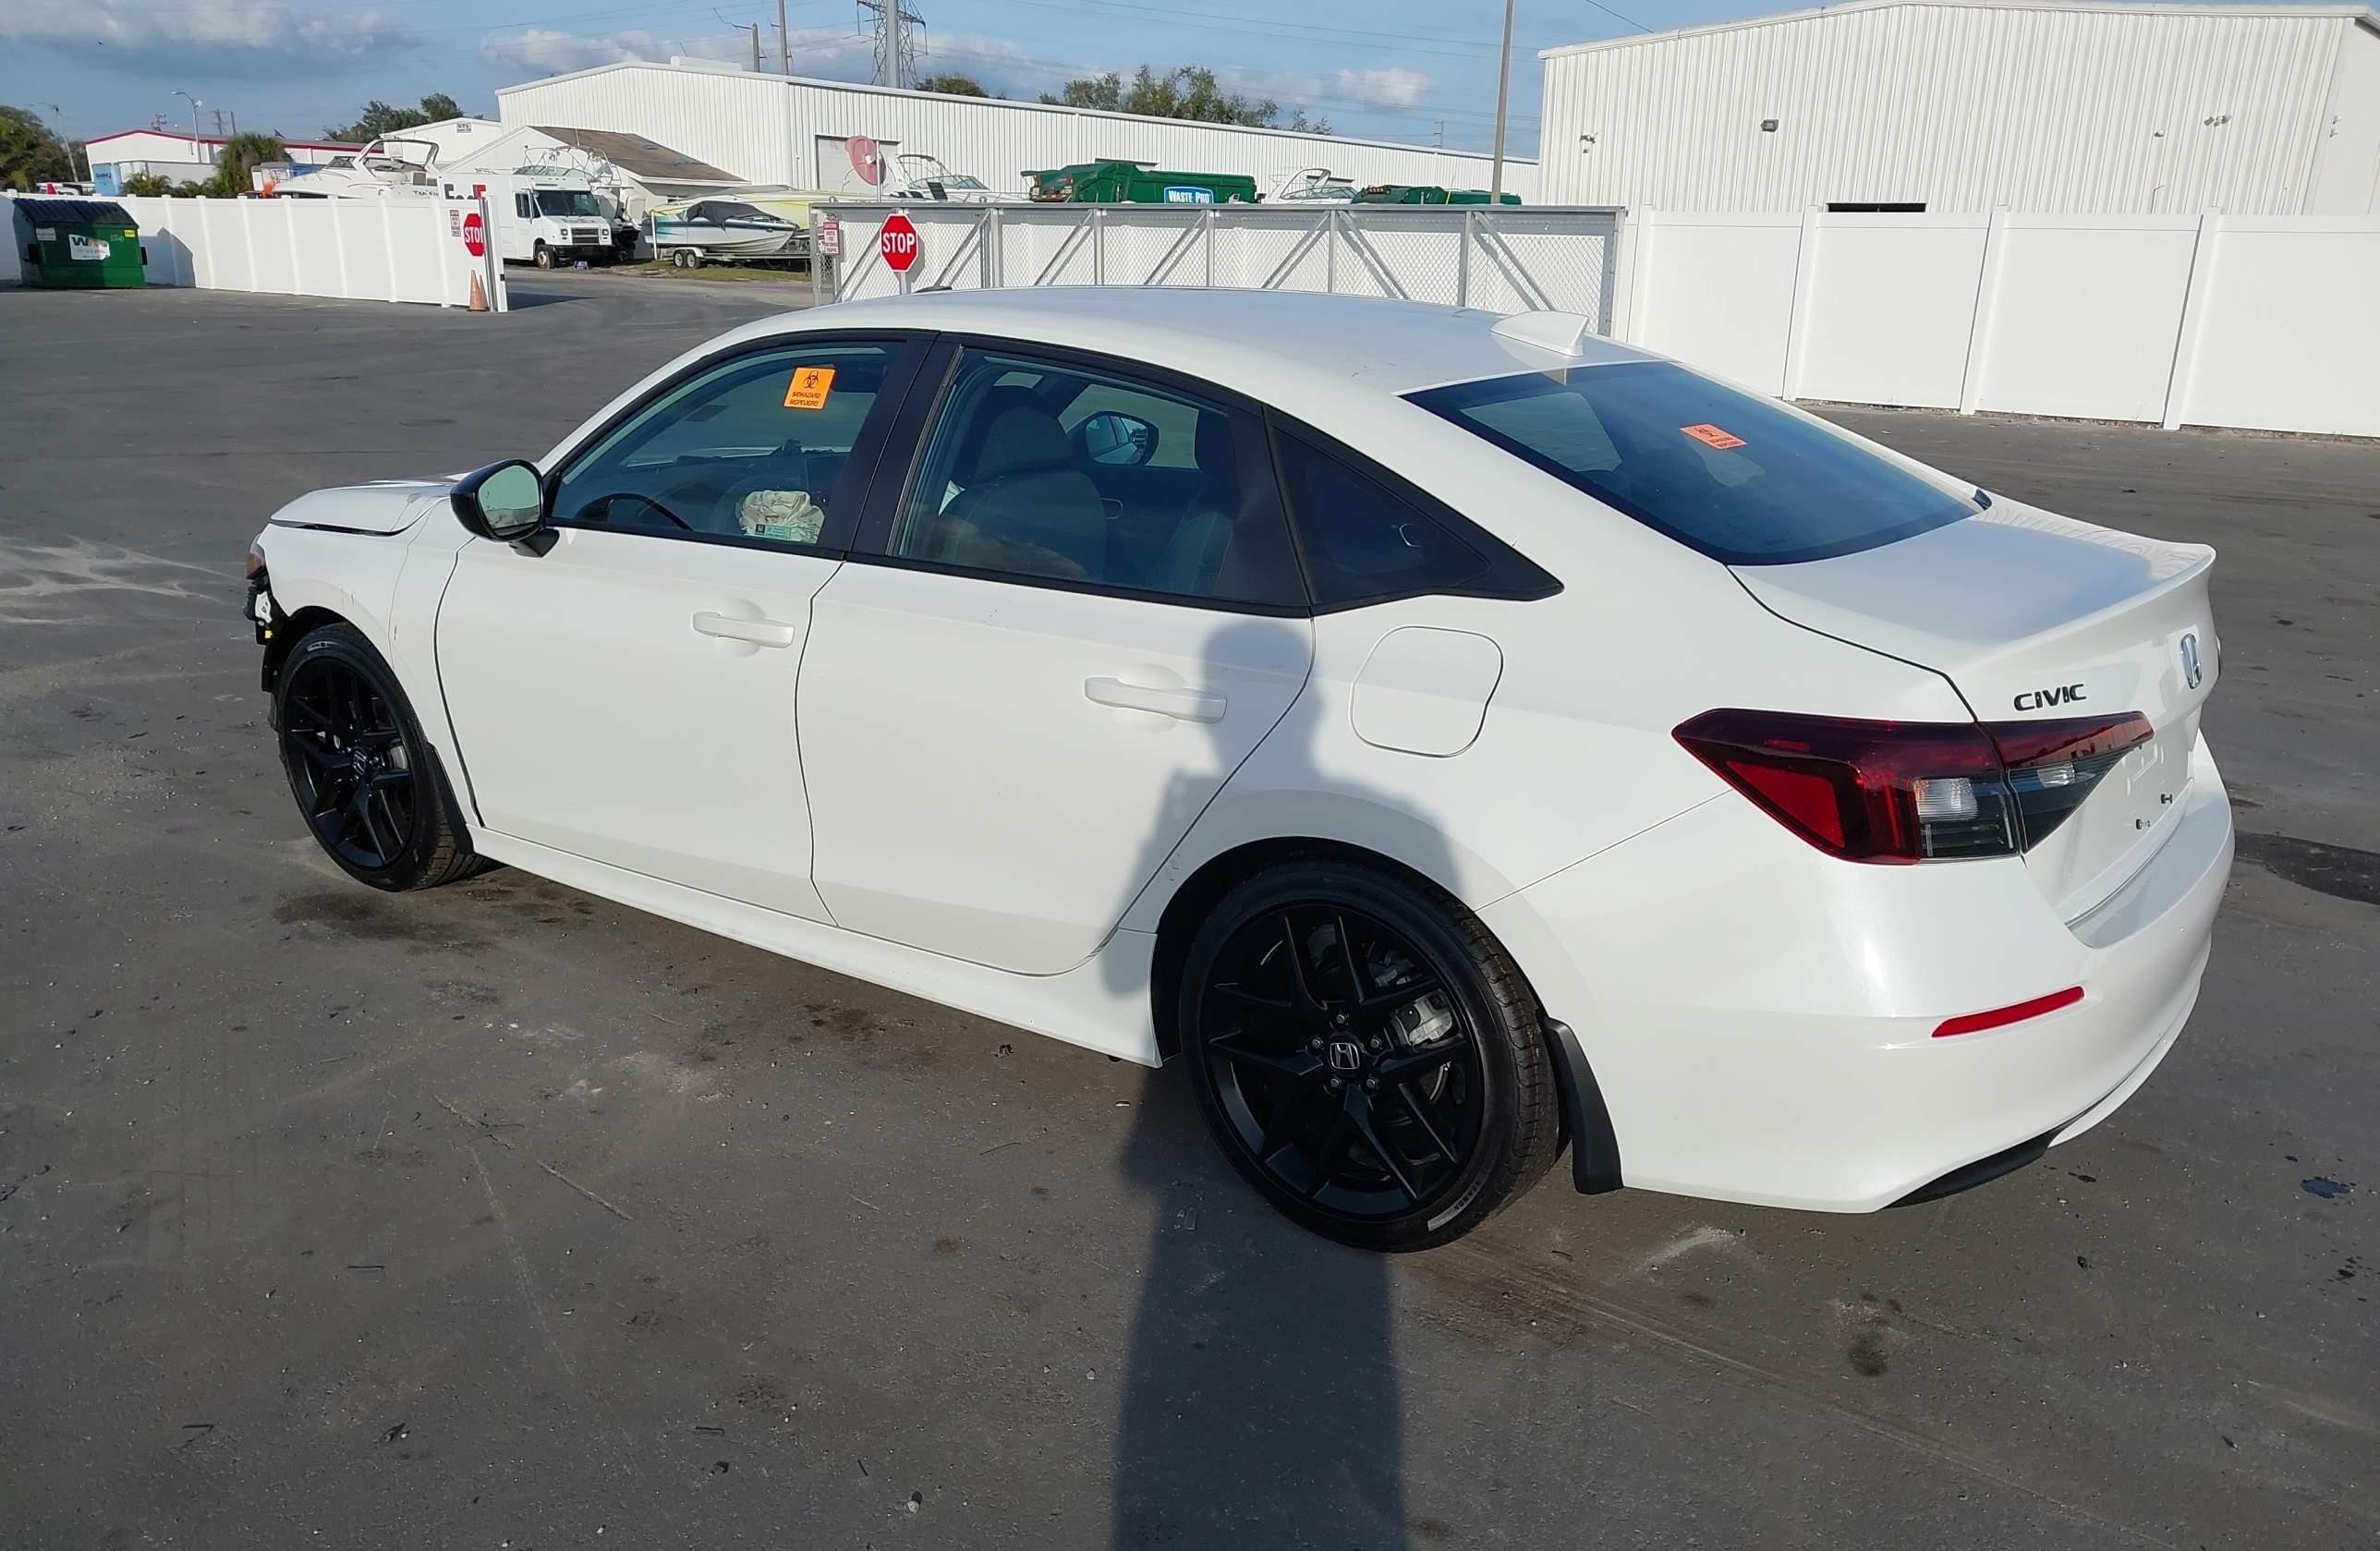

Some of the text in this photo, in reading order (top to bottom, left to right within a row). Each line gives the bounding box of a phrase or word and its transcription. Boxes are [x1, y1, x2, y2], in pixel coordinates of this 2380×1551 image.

[1168, 190, 1209, 204] WASTE PRO
[882, 232, 916, 254] STOP
[2013, 683, 2087, 711] CIVIC
